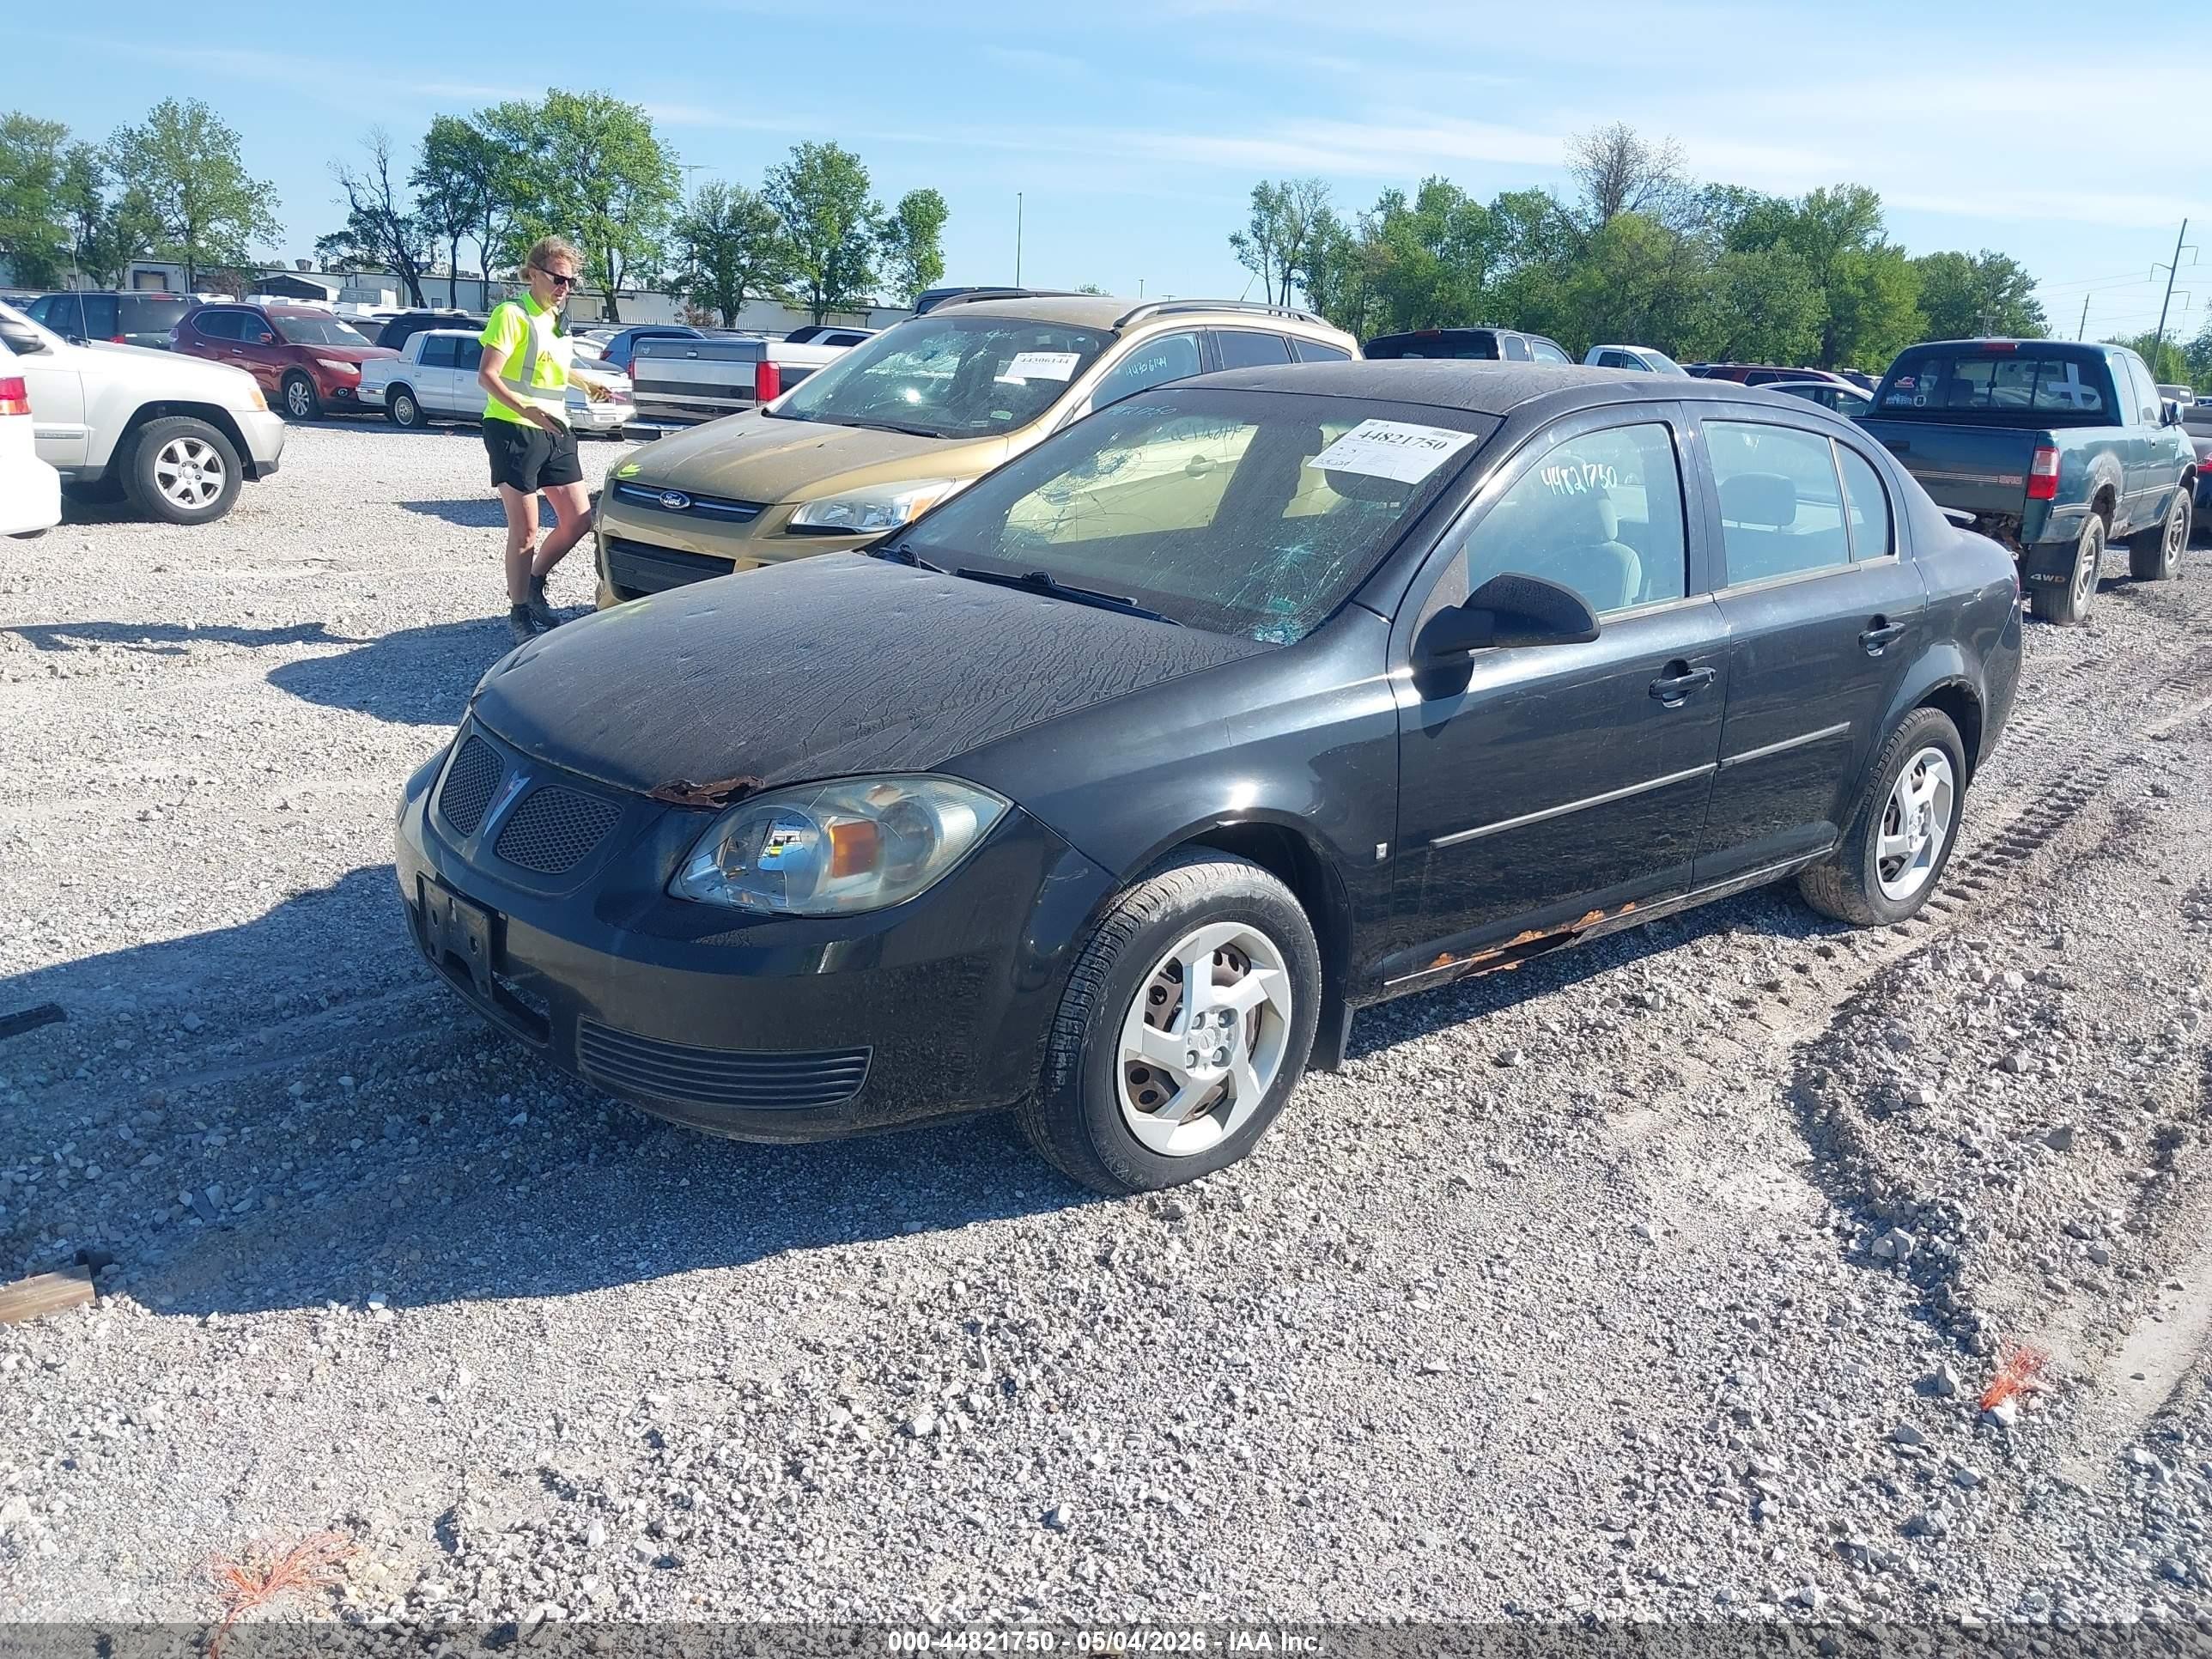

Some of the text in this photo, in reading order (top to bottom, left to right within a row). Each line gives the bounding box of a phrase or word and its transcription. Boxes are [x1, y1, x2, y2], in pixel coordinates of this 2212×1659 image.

[1019, 356, 1070, 365] 44306144
[1358, 429, 1448, 451] 44821750
[1540, 463, 1618, 495] 44821750
[663, 493, 682, 506] Ford
[2030, 573, 2066, 583] 4WD
